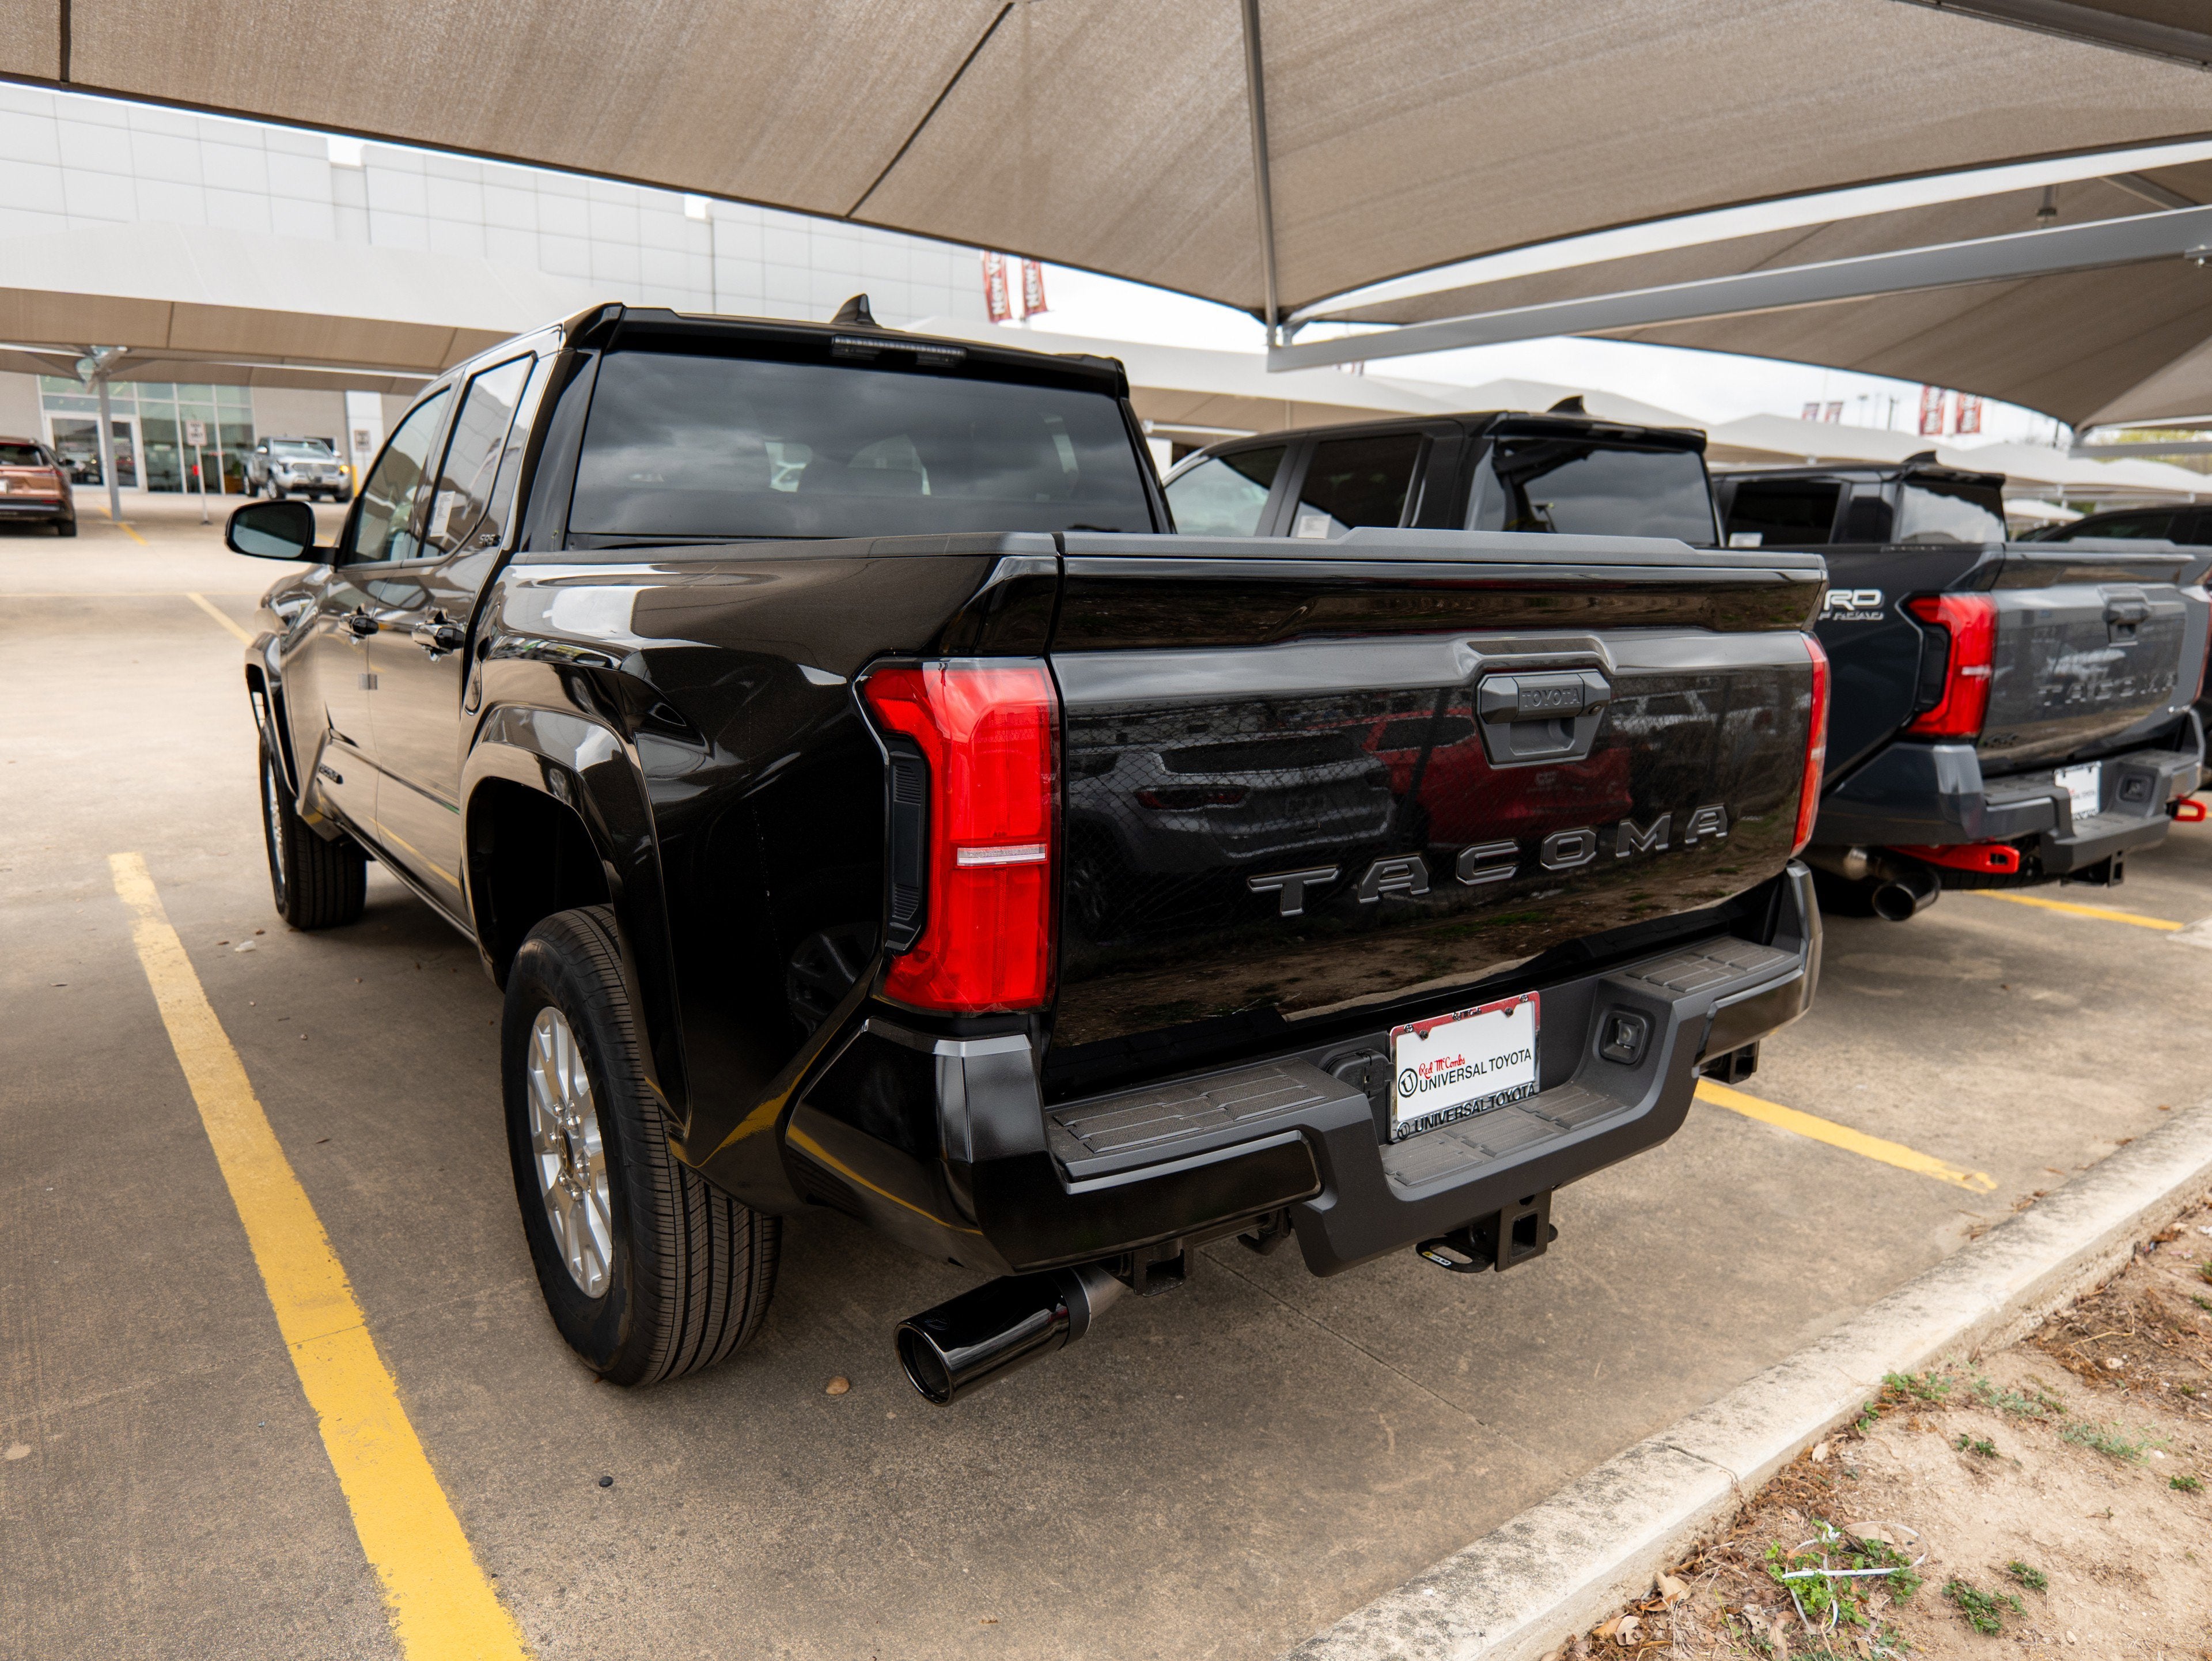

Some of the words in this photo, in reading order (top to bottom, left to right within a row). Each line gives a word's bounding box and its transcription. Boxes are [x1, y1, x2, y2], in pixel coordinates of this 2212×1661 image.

[1824, 589, 1882, 611] RD
[1521, 687, 1581, 707] TOYOTA
[1247, 804, 1727, 917] TACOMA
[1419, 1062, 1433, 1079] Red
[1434, 1054, 1465, 1072] McCombs
[1419, 1061, 1487, 1092] UNIVERSAL
[1488, 1048, 1532, 1072] TOYOTA
[1414, 1097, 1488, 1133] UNIVERSAL
[1487, 1081, 1536, 1108] TOYOTA
